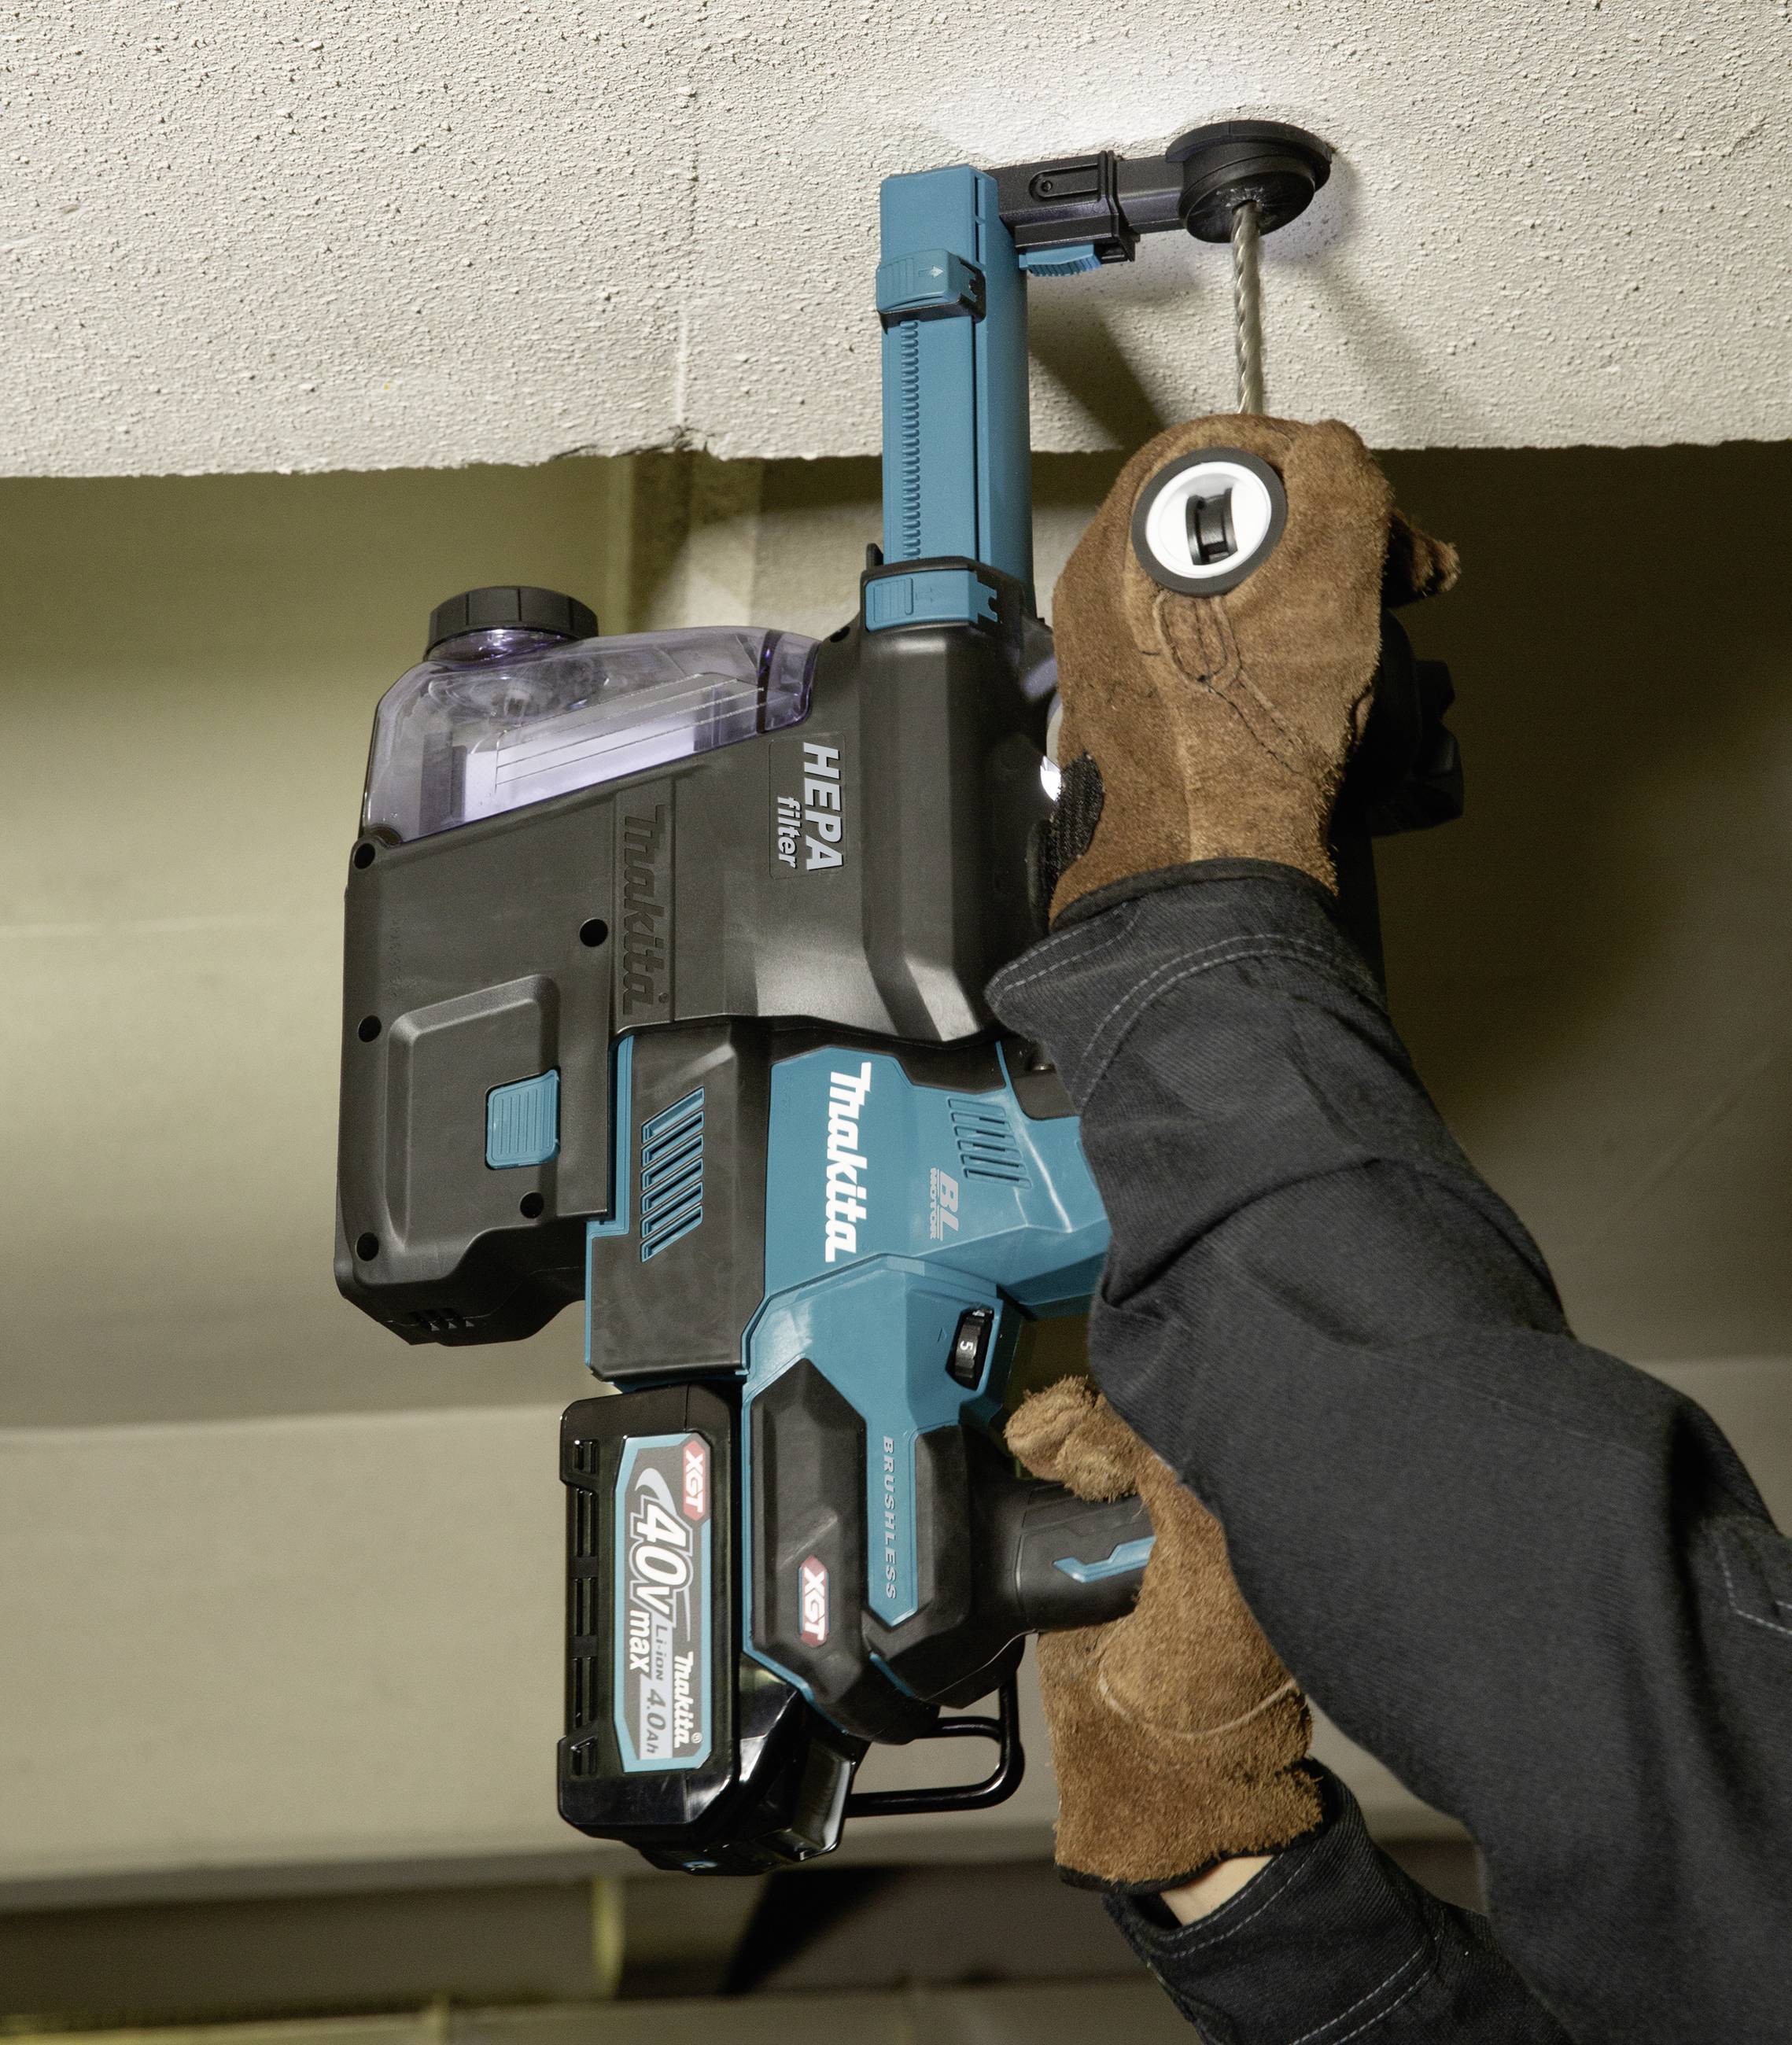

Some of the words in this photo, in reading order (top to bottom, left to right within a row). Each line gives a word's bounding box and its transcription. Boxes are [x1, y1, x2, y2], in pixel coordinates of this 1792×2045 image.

[776, 794, 801, 868] filter
[803, 742, 844, 873] HEPA
[929, 1167, 938, 1240] MOTOR
[939, 1170, 959, 1241] BL
[960, 1339, 974, 1350] 5
[685, 1450, 705, 1513] XGT
[882, 1435, 898, 1601] BRUSHLESS
[802, 1566, 826, 1641] XGT
[629, 1610, 651, 1675] max
[645, 1688, 666, 1755] 4.0Ah
